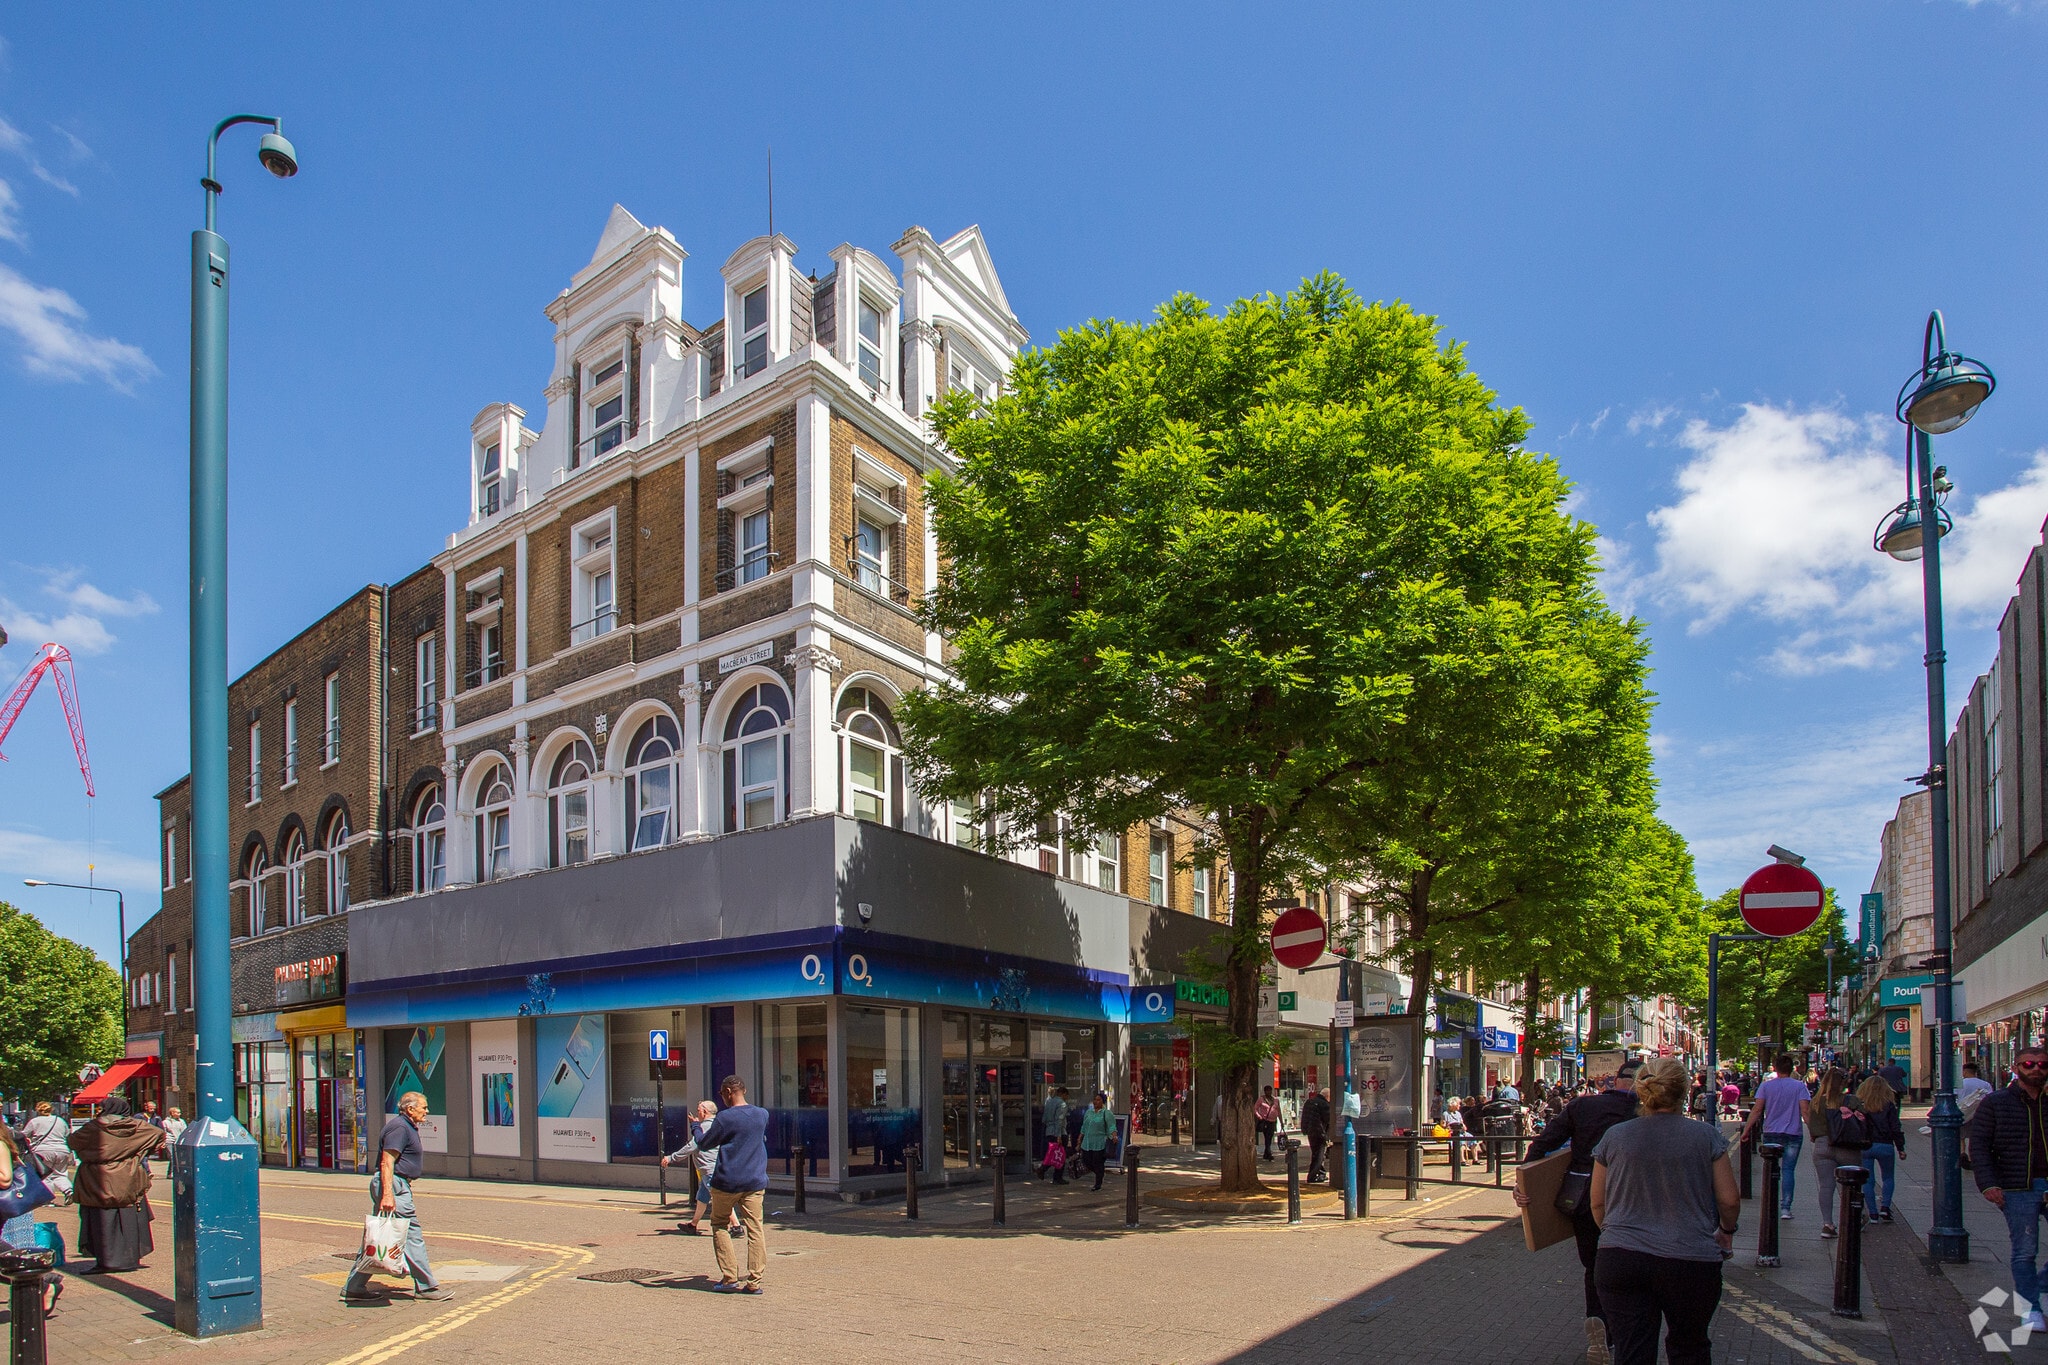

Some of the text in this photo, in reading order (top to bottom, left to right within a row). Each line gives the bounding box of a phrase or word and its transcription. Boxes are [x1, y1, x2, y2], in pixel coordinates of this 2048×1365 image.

[720, 656, 748, 671] MACBEAN
[749, 648, 770, 662] STREET
[275, 954, 338, 984] PHONE SHOP
[1176, 980, 1229, 1007] DEICHM
[1893, 986, 1920, 997] Poun
[1280, 994, 1293, 1006] D
[1895, 1020, 1908, 1031] £1
[1369, 1042, 1397, 1050] follow-on
[1890, 1048, 1911, 1056] Valu
[478, 1054, 497, 1062] HUAWEI
[629, 1096, 643, 1104] Create
[552, 1129, 574, 1137] HUAWEI
[583, 1130, 591, 1138] Pro
